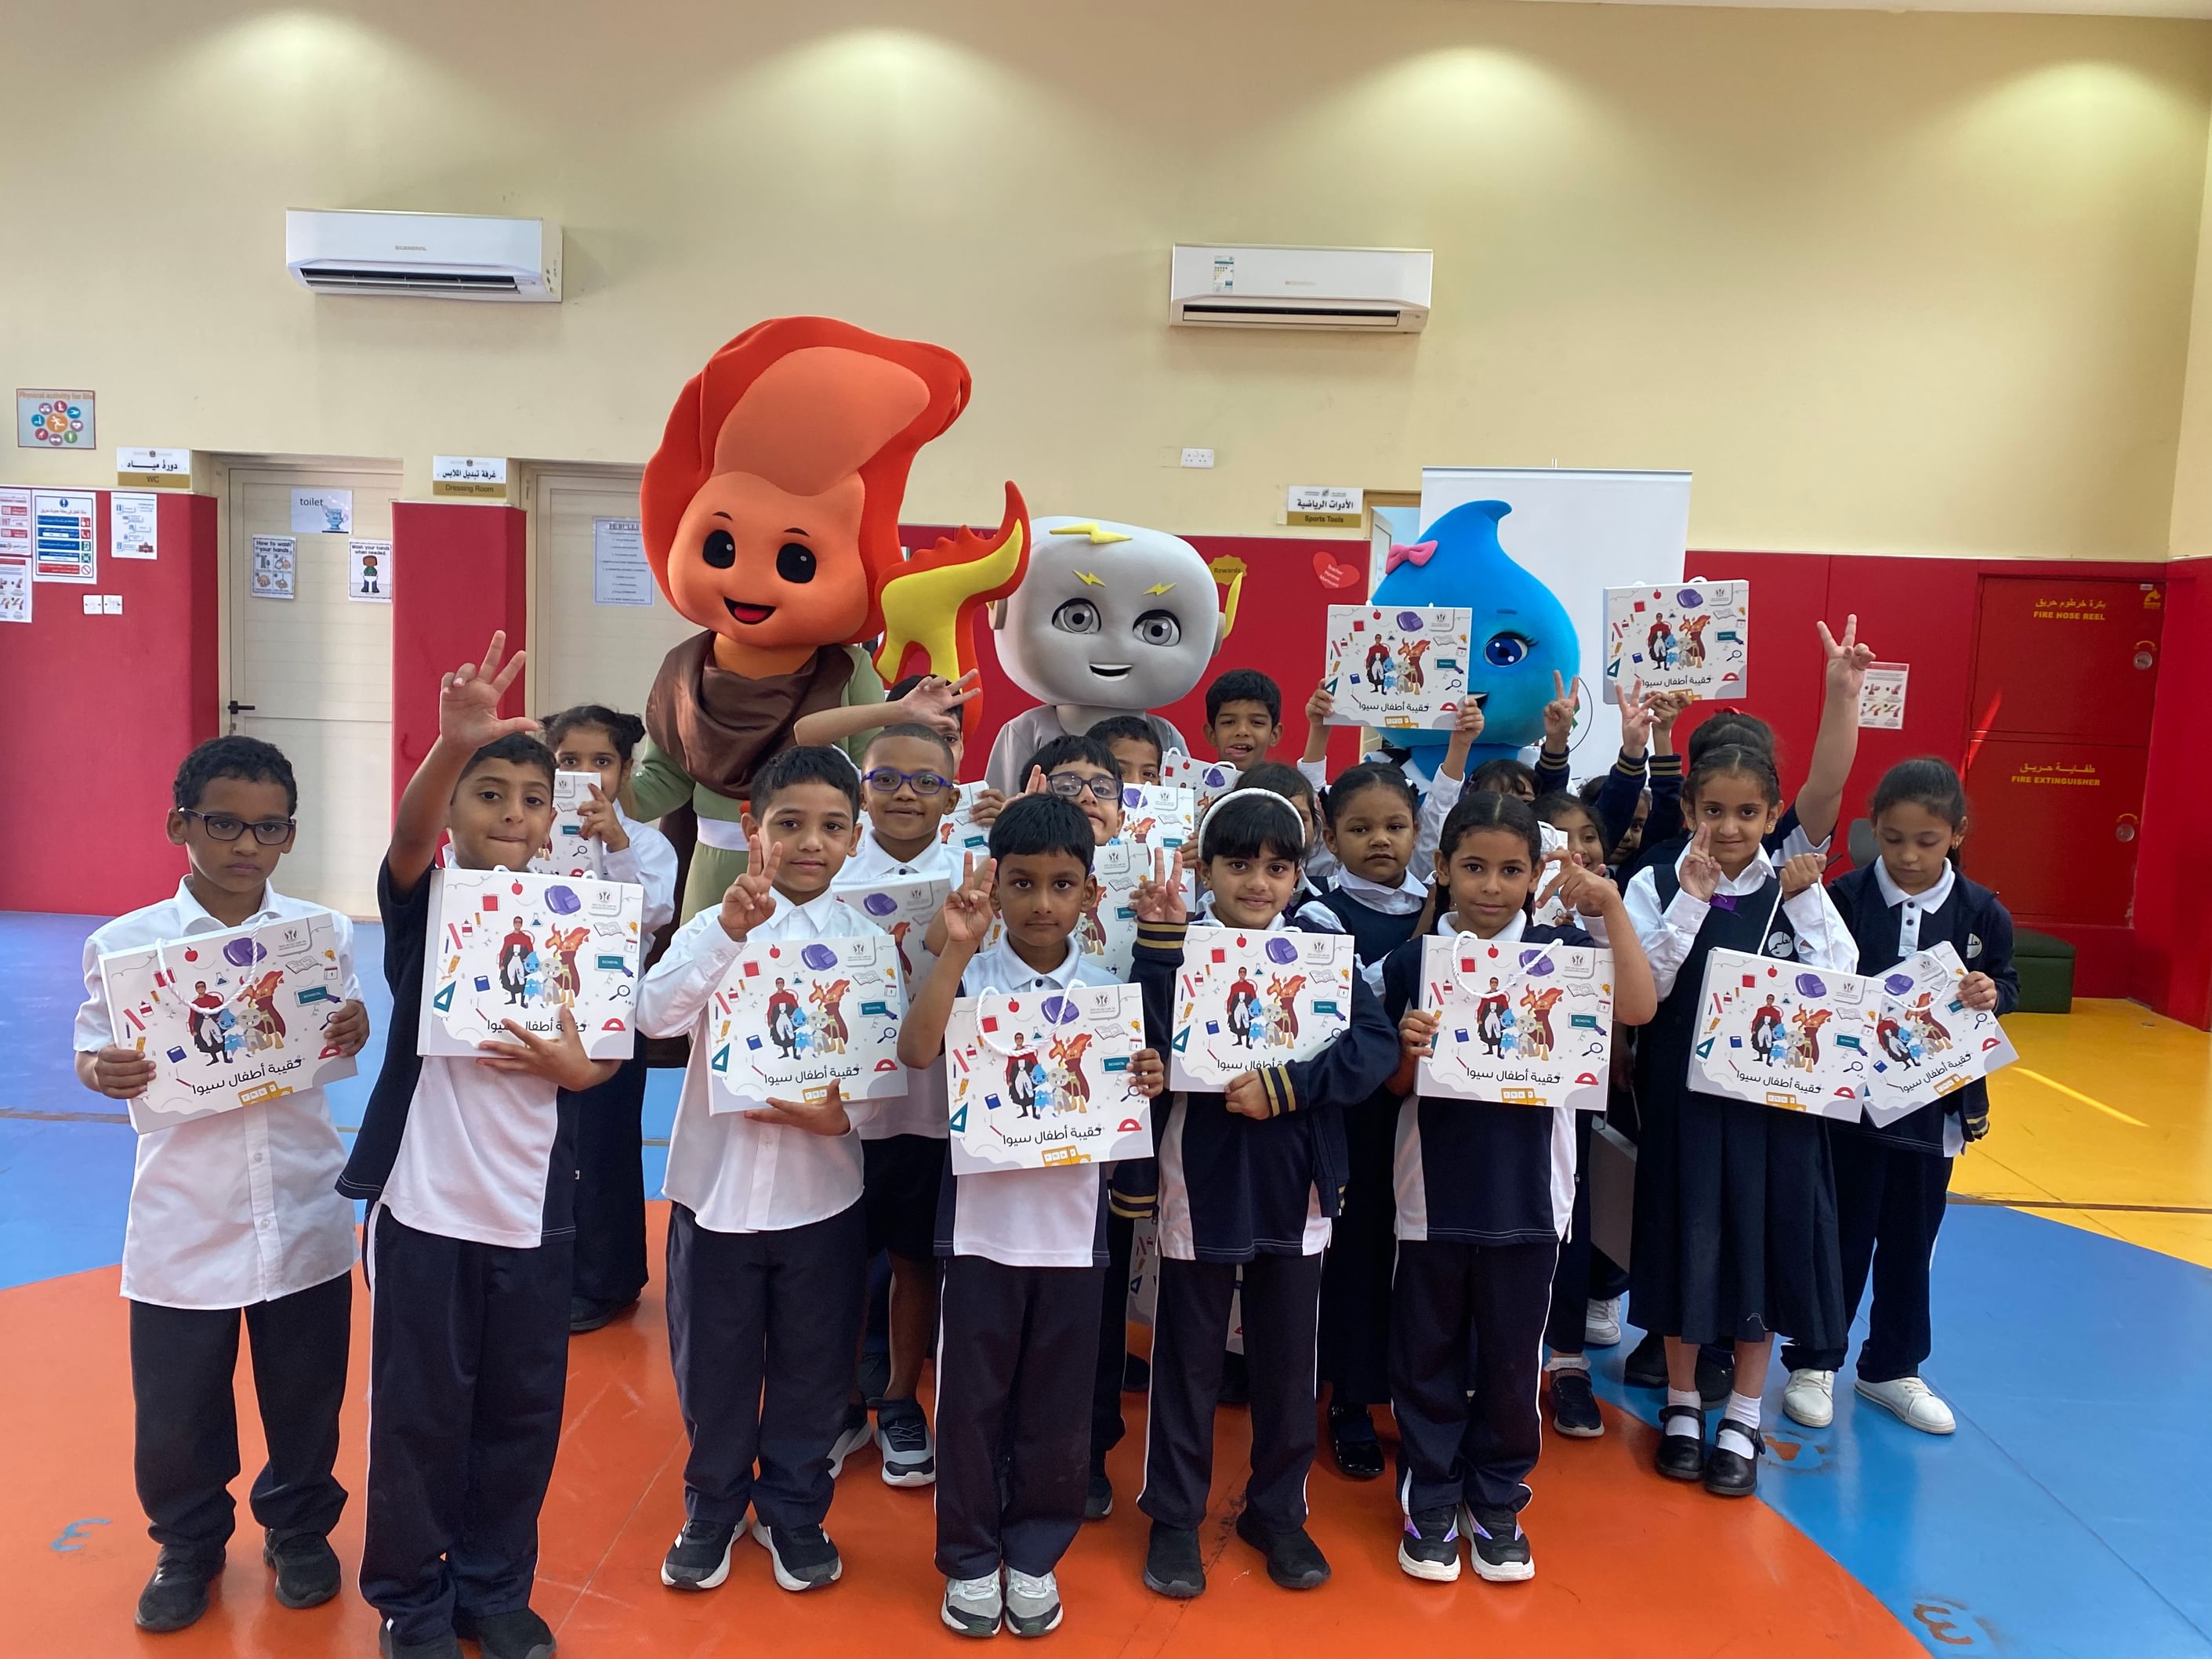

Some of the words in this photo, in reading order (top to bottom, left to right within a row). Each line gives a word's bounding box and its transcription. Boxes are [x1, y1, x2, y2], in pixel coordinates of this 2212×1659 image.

[442, 469, 462, 478] الملابس
[462, 470, 480, 480] تبديل
[481, 470, 496, 480] غرفة
[445, 484, 473, 493] Dressing
[299, 498, 324, 506] toilet
[1297, 499, 1327, 510] الرياضية
[1329, 499, 1354, 511] الأدوات
[2035, 598, 2058, 608] حريق
[2059, 598, 2087, 608] خرطوم
[2089, 599, 2107, 609] بكرة
[1664, 675, 1688, 686] أطفال
[1380, 701, 1405, 712] أطفال
[2019, 763, 2054, 773] حريق
[2034, 777, 2101, 786] EXTINGUISHER
[1217, 1060, 1242, 1071] سيوا
[229, 1063, 266, 1087] أطفال
[796, 1065, 828, 1083] أطفال
[1467, 1067, 1493, 1080] سيوا
[1496, 1068, 1529, 1082] أطفال
[1737, 1070, 1761, 1083] سيوا
[1924, 1062, 1948, 1083] أطفال
[764, 1074, 792, 1086] سيوا
[1763, 1076, 1793, 1089] أطفال
[191, 1080, 225, 1095] سيوا
[1900, 1079, 1922, 1094] سيوا
[1035, 1125, 1068, 1144] أطفال
[1003, 1135, 1032, 1147] سيوا
